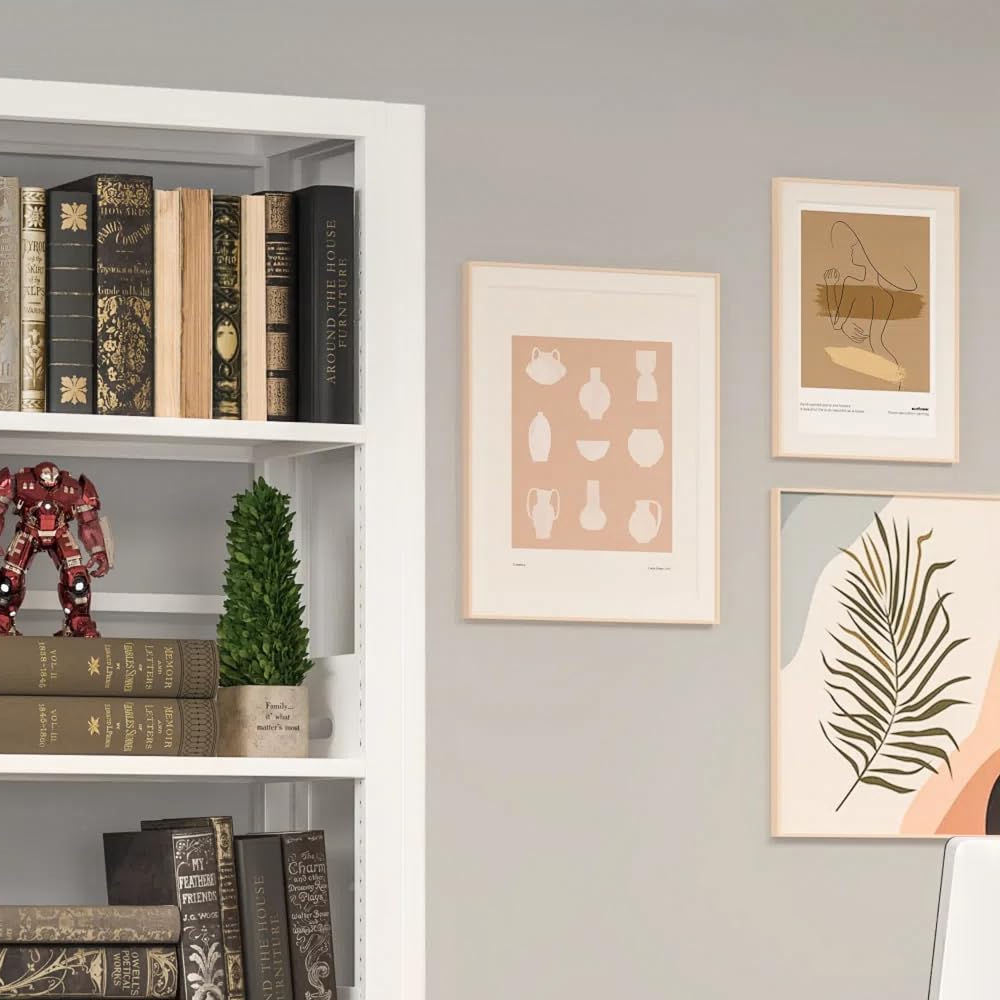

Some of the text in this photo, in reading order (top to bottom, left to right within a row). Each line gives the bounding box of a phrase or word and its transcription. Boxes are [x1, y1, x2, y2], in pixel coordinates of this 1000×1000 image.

[326, 219, 336, 384] AROUND THE HOUSE
[338, 258, 347, 348] FURNITURE
[145, 644, 154, 690] LETTERS
[164, 646, 174, 689] MEMOIR
[145, 705, 154, 749] LETTERS
[164, 706, 174, 748] MEMOIR
[192, 858, 204, 871] MY
[288, 862, 325, 875] Charm
[182, 891, 218, 904] FRIENDS
[254, 876, 268, 931] HOUSE
[111, 953, 121, 986] WORKS
[122, 950, 130, 990] POETICAL
[131, 950, 141, 996] OWELL'S
[260, 941, 271, 974] THE
